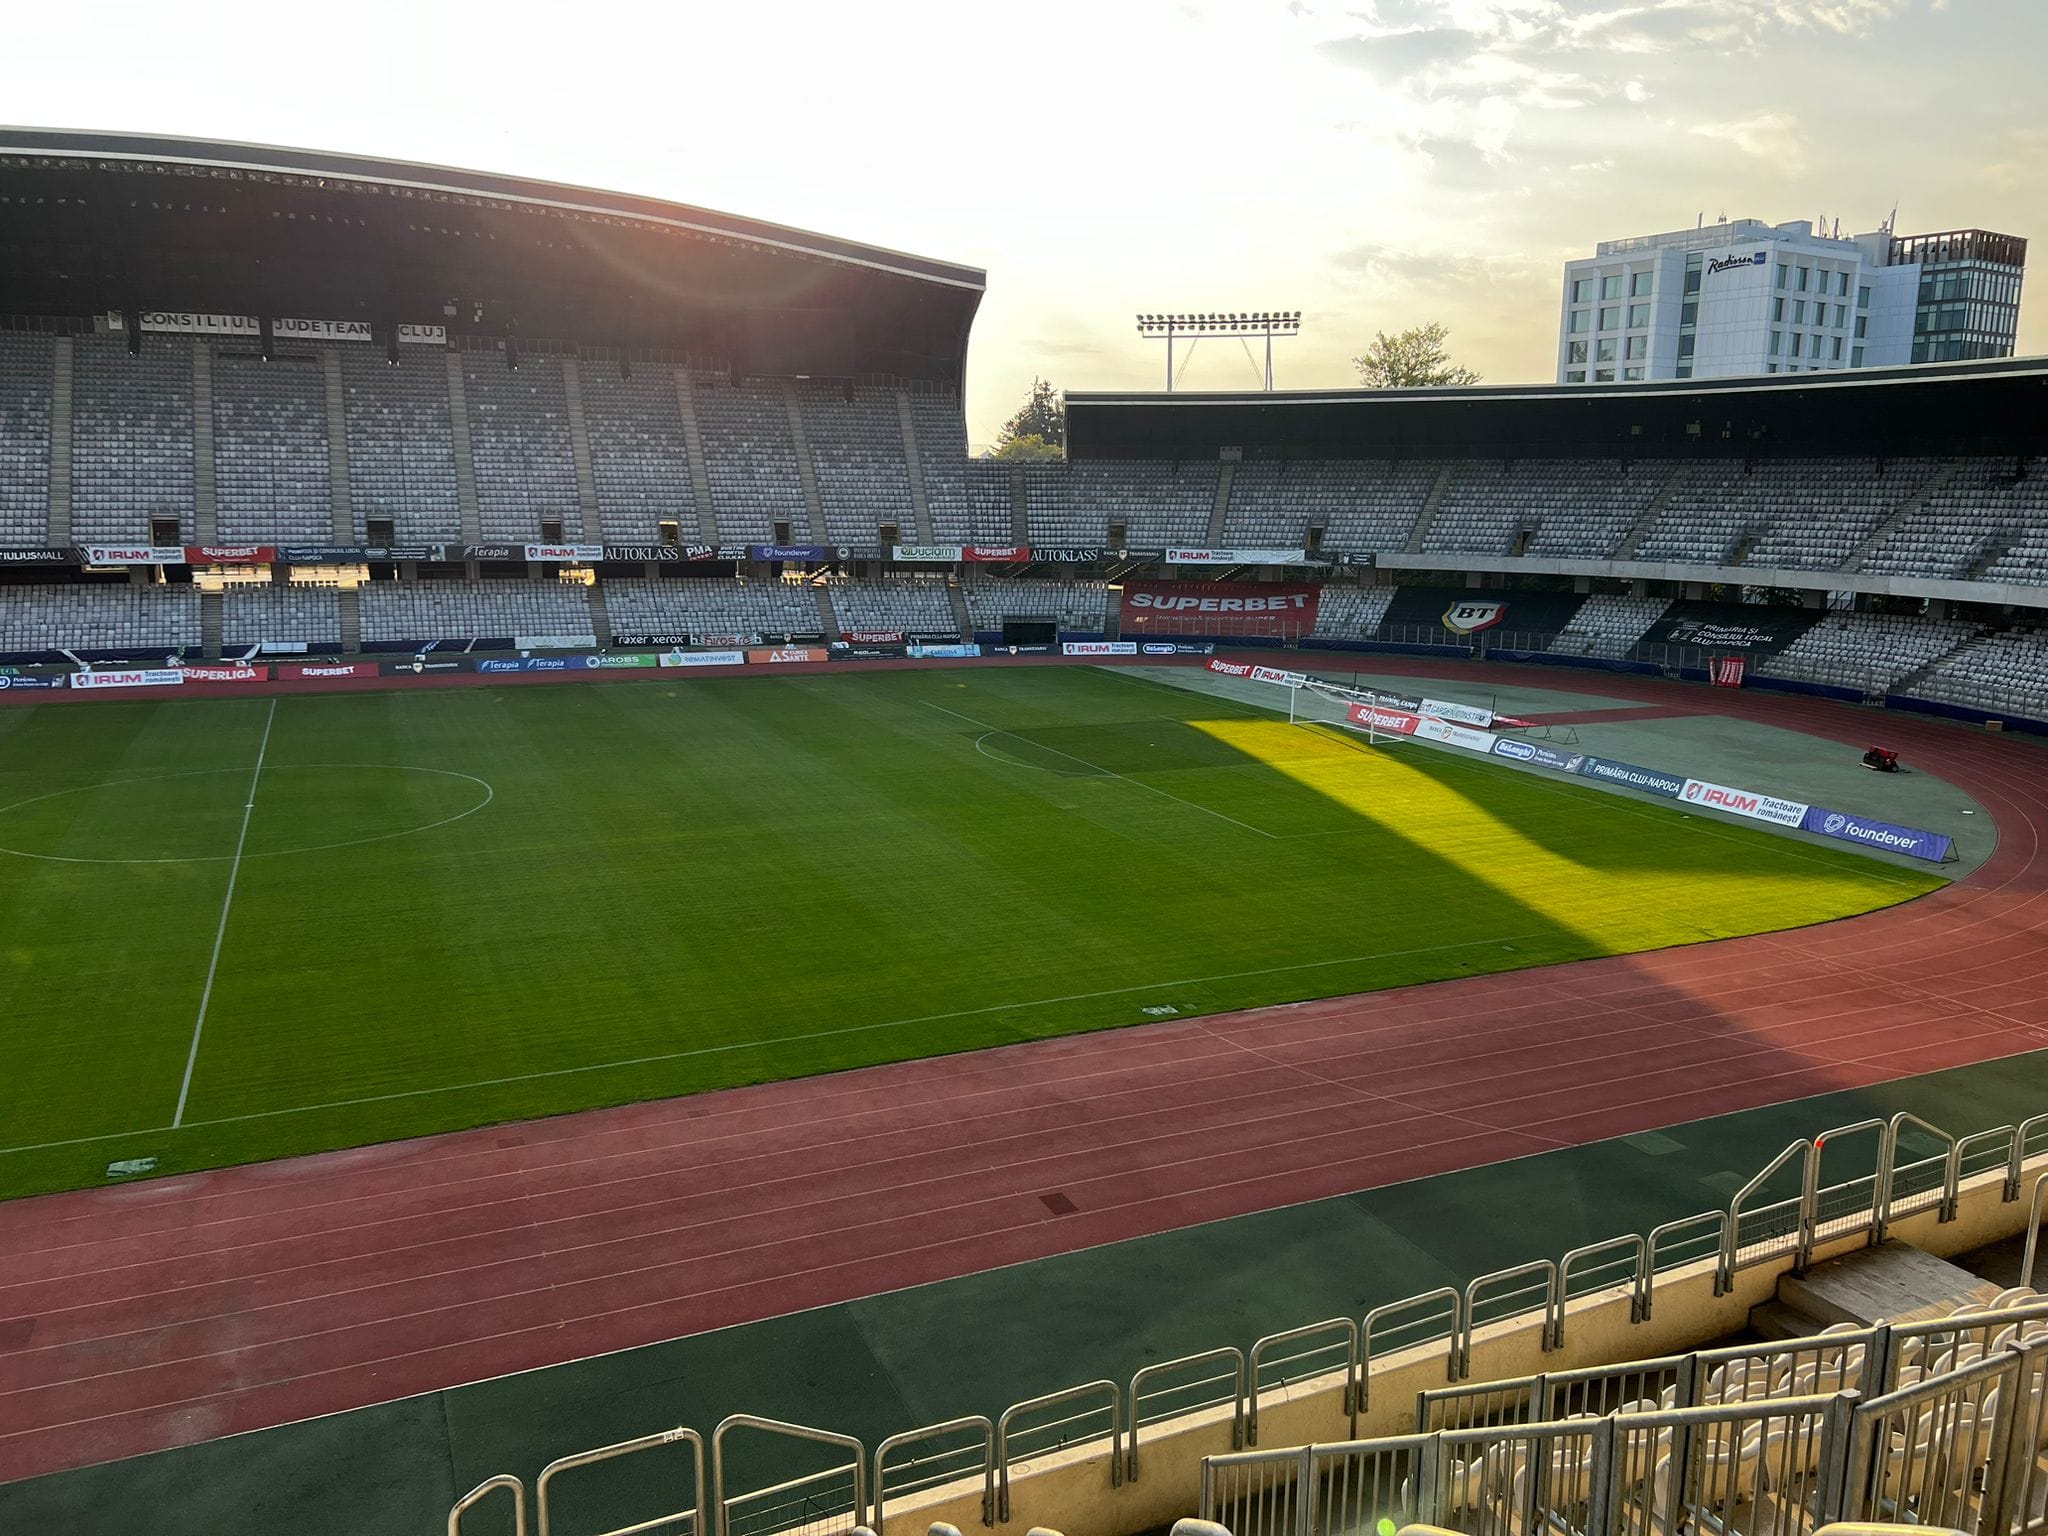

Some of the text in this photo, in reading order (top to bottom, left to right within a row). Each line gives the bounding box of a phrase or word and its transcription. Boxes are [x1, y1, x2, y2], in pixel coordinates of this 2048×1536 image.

[1707, 254, 1754, 275] Radisson
[140, 313, 258, 329] CONSILIUL
[399, 324, 445, 338] CLUJ
[108, 551, 149, 560] IRUM
[201, 546, 259, 557] SUPERBET
[472, 546, 509, 558] Terapia
[540, 549, 576, 557] IRUM
[603, 547, 679, 561] AUTOKLASS
[686, 545, 713, 557] PMA
[774, 548, 811, 558] foundever
[974, 547, 1018, 556] SUPERBET
[1030, 549, 1099, 562] AUTOKLASS
[1179, 551, 1210, 560] IRUM
[1129, 593, 1309, 612] SUPERBET
[1456, 607, 1494, 619] BT
[652, 635, 685, 645] xerox
[851, 632, 903, 643] SUPERBET
[1743, 634, 1773, 642] LOCAL
[1078, 645, 1110, 653] IRUM
[600, 656, 640, 664] AROBS
[781, 650, 809, 662] SANTE
[488, 660, 520, 670] Terapia
[534, 659, 565, 669] Terapia
[1210, 660, 1251, 675] SUPERBET
[183, 667, 257, 680] SUPERLIGA
[301, 665, 356, 677] SUPERBET
[1260, 671, 1286, 683] IRUM
[94, 674, 142, 685] IRUM
[1356, 708, 1410, 729] SUPERBET
[1594, 764, 1681, 793] PRIMĂRIA CLUJ-NAPOCA
[1703, 787, 1758, 813] IRUM
[1760, 797, 1803, 815] Tractoare
[1757, 807, 1800, 825] românești
[1844, 821, 1918, 850] foundever
